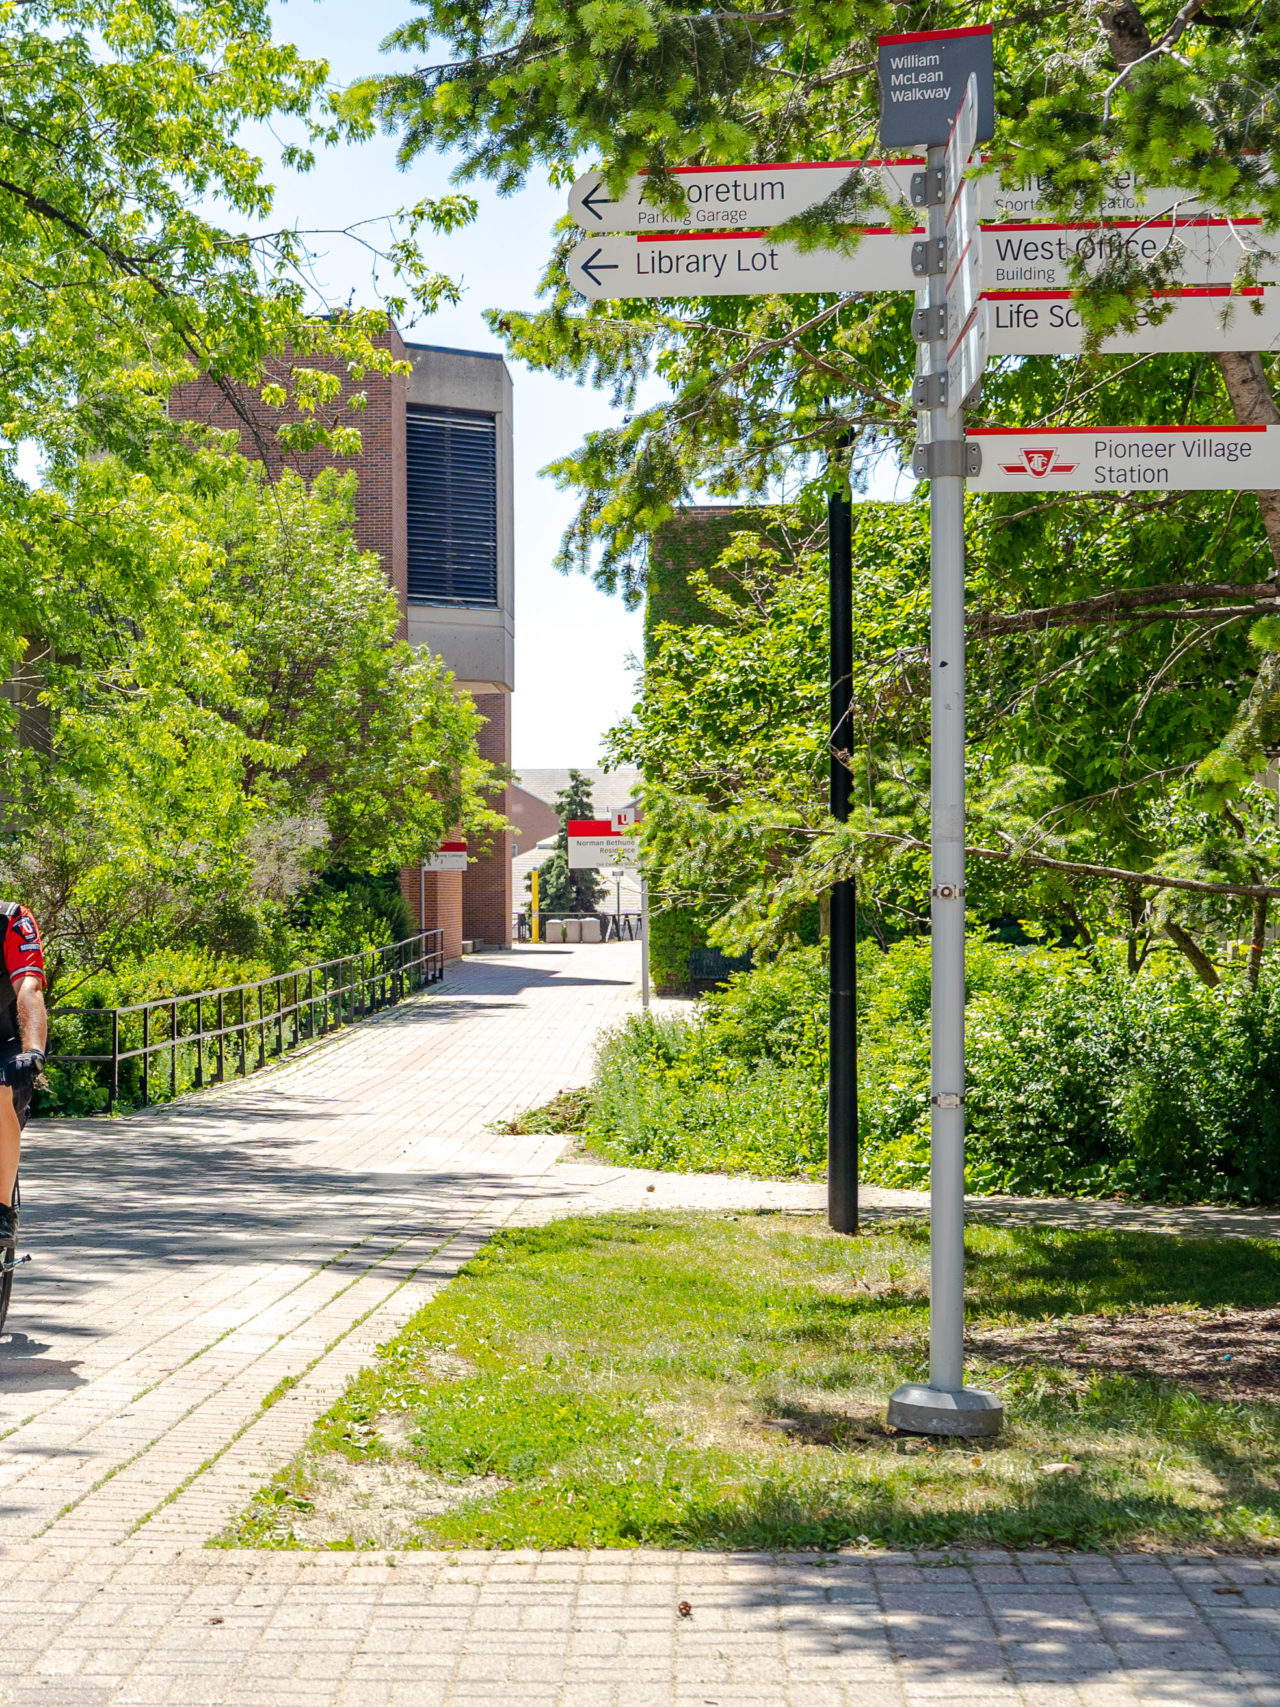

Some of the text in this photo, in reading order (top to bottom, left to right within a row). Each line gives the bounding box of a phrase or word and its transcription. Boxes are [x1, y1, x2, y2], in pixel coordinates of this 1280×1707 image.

[890, 54, 940, 69] William
[891, 71, 944, 86] McLean
[890, 86, 952, 103] Walkway
[637, 179, 786, 206] oretum
[995, 197, 1042, 215] Sport
[695, 208, 748, 224] Garage
[995, 233, 1157, 262] West Office
[636, 248, 780, 279] Library Lot
[996, 266, 1056, 283] Building
[995, 303, 1039, 329] Life
[1094, 438, 1252, 462] Pioneer Village
[1094, 464, 1169, 484] Station
